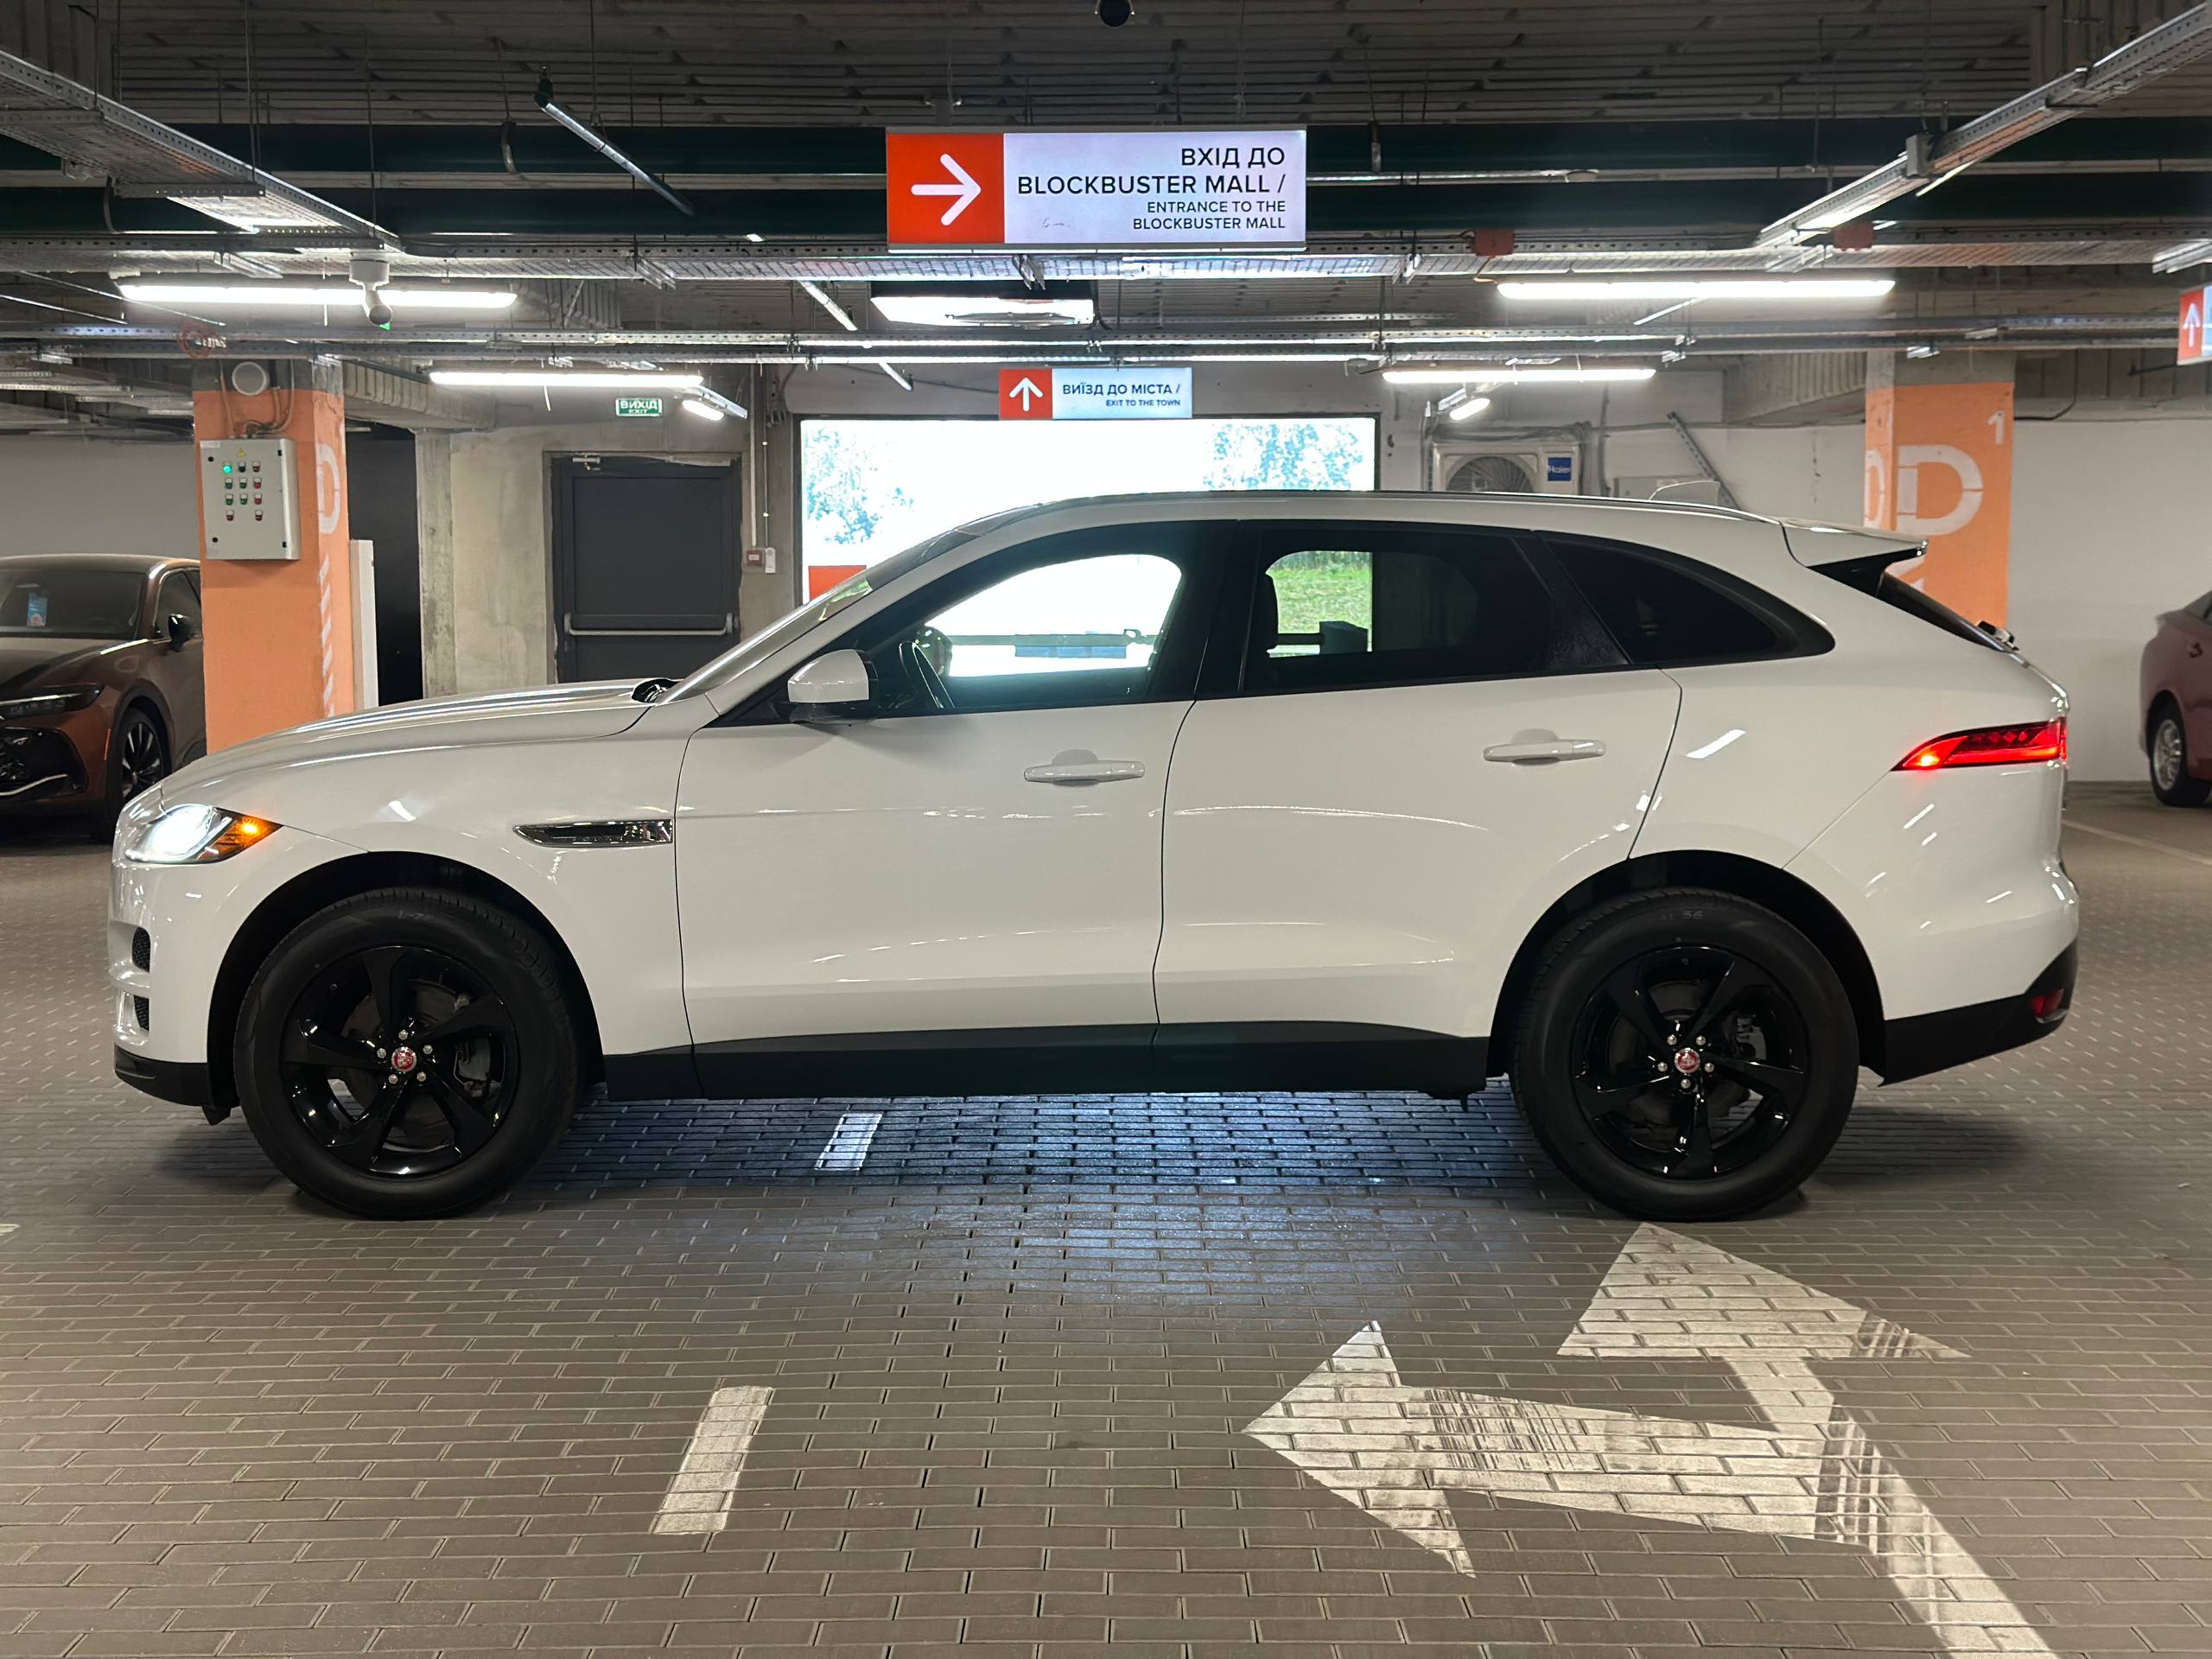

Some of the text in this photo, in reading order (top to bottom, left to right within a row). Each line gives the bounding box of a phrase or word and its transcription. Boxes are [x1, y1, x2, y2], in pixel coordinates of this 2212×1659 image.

[1180, 147, 1286, 169] ВХІД ДО
[1018, 175, 1196, 194] BLOCKBUSTER
[1205, 175, 1270, 194] MALL
[1147, 200, 1286, 213] ENTRANCE TO THE
[1133, 217, 1286, 230] BLOCKBUSTER MALL
[1063, 382, 1103, 396] ВИЇЗД
[1107, 384, 1128, 396] ДО
[1131, 384, 1173, 395] МІСТА
[620, 400, 658, 410] ВИХІД
